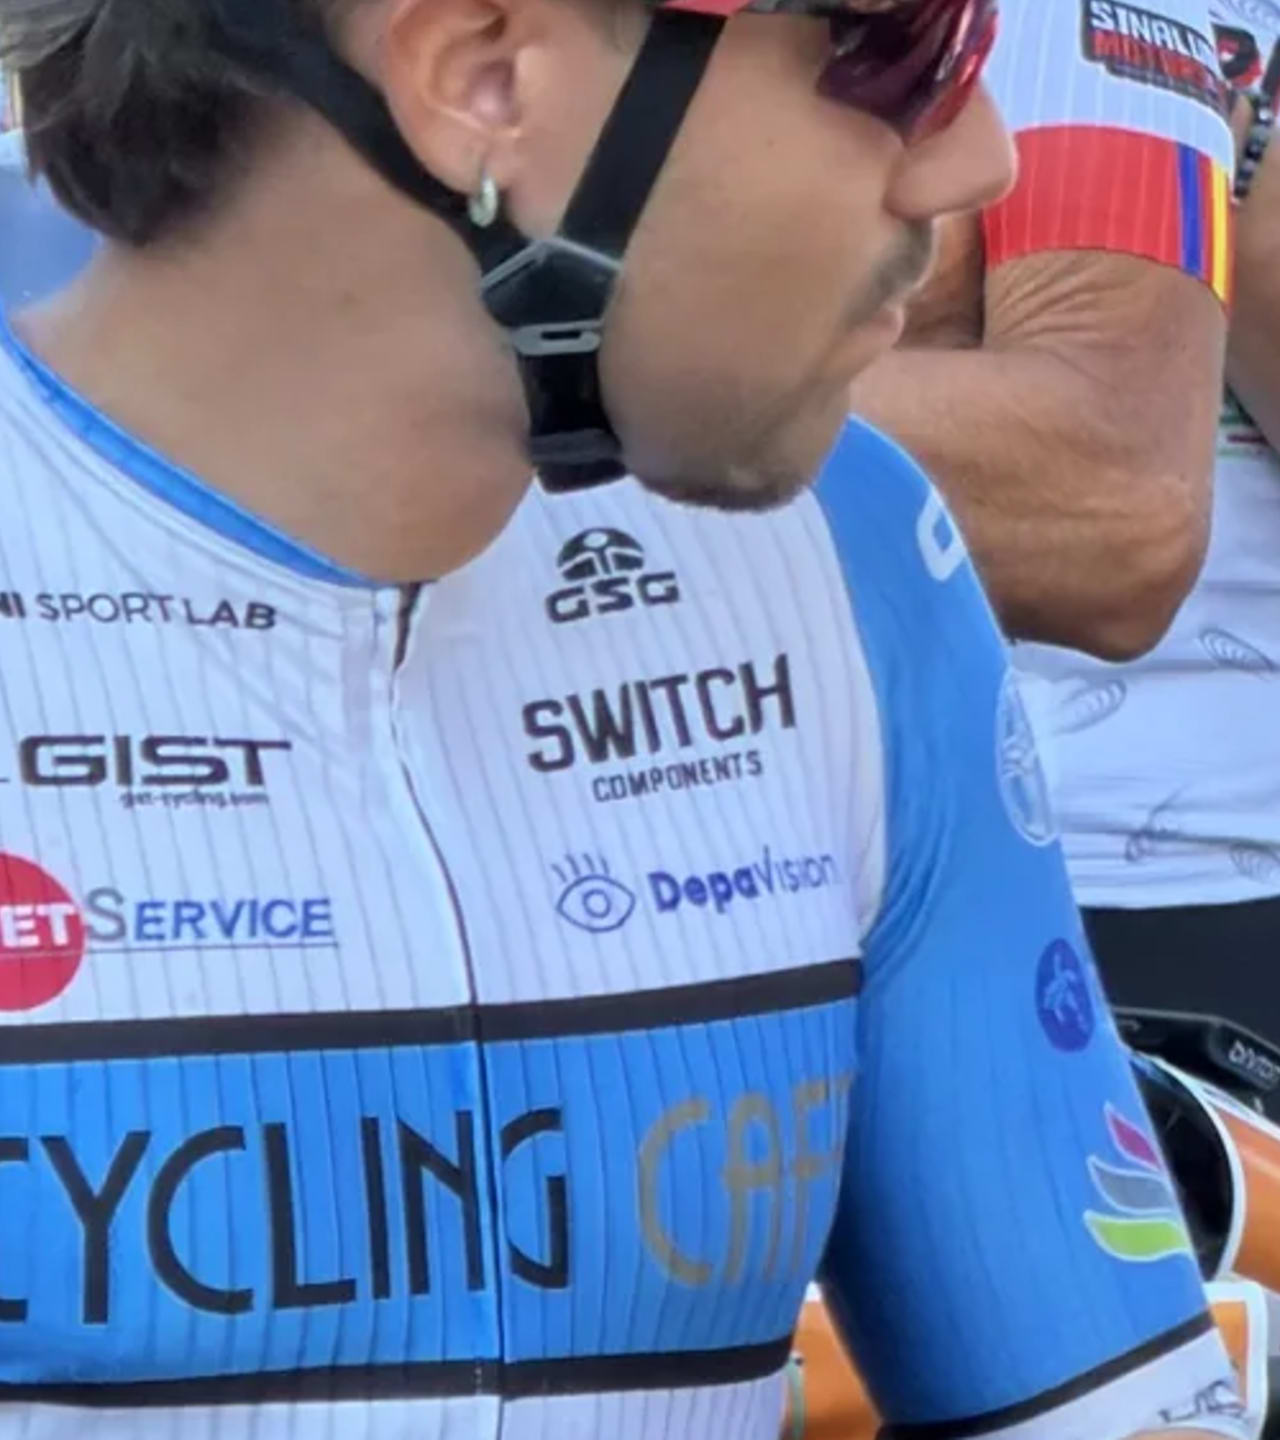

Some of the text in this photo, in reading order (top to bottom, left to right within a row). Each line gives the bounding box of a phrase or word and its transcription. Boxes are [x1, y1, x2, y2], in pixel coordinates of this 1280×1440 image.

[35, 592, 175, 623] SPORT
[182, 598, 278, 631] LAB
[545, 569, 680, 625] GSG
[521, 653, 797, 773] SWITCH
[20, 734, 292, 788] GIST
[592, 749, 764, 804] COMPONENTS
[647, 844, 840, 915] DepaVision
